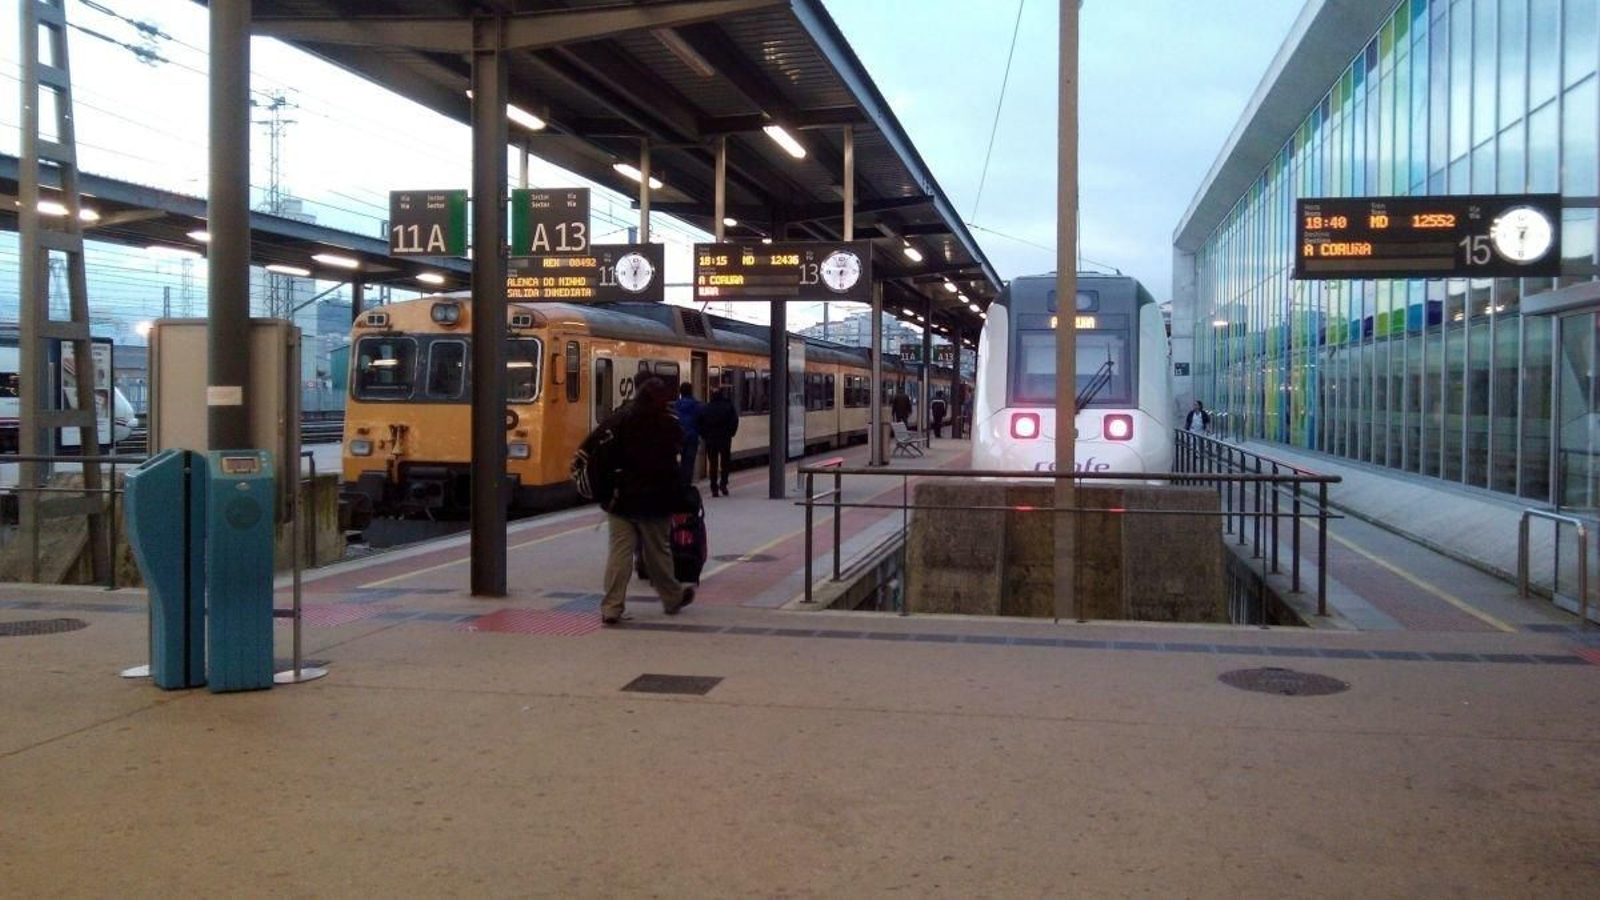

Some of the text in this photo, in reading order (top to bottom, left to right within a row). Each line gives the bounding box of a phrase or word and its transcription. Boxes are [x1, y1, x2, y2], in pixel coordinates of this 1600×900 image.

[1412, 213, 1456, 228] 12552
[392, 223, 446, 253] 11 A
[531, 221, 586, 252] A 13
[1304, 243, 1314, 257] A
[1459, 234, 1492, 265] 15
[506, 276, 540, 288] ALENCA
[599, 266, 618, 286] 11
[698, 275, 706, 286] A
[799, 263, 820, 285] 13
[507, 288, 540, 299] SALIDA
